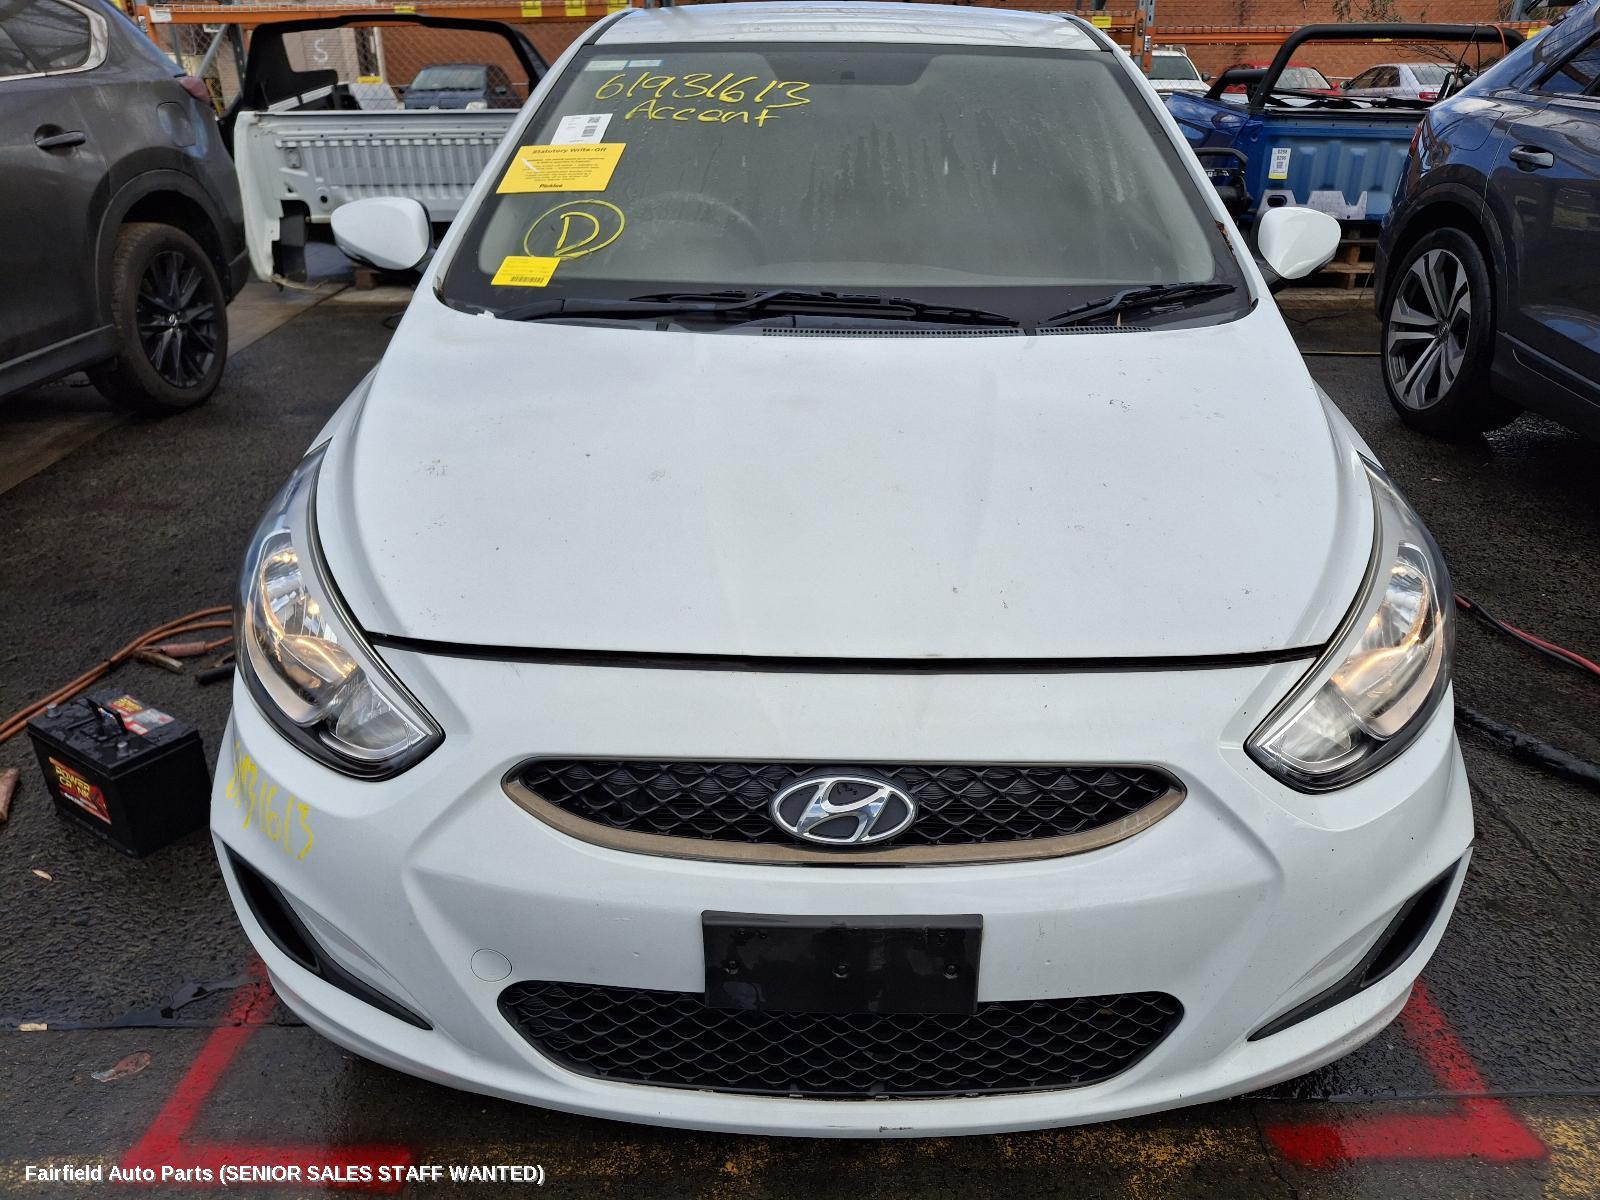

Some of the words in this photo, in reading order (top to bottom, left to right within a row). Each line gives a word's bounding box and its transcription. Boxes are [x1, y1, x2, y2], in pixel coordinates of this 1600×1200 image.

[595, 71, 811, 108] 61931613
[55, 766, 90, 792] POWER
[59, 776, 90, 799] CRNK
